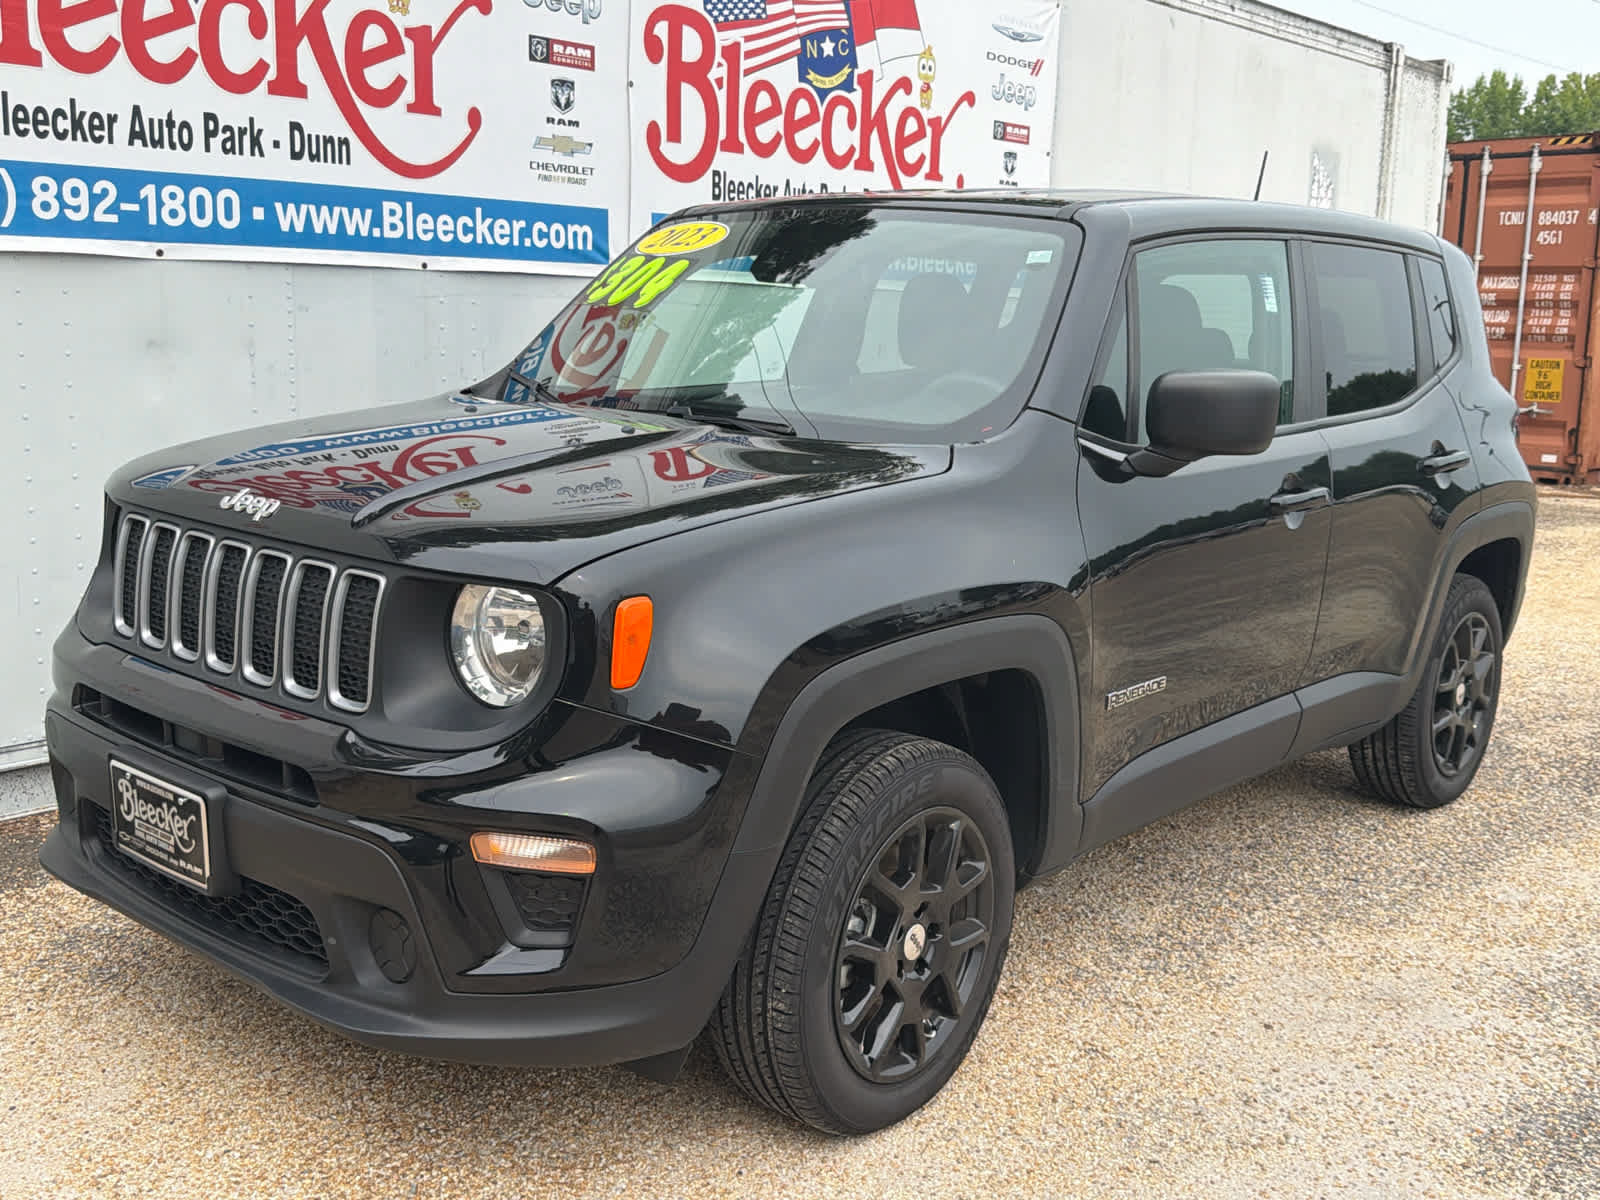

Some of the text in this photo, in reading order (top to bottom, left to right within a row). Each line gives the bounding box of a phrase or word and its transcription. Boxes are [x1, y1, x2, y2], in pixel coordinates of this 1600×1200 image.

[553, 44, 592, 58] RAM
[806, 39, 818, 58] N
[986, 51, 1037, 71] DODGE
[644, 4, 976, 189] Bleecker
[991, 73, 1036, 111] Jeep
[546, 116, 580, 128] RAM
[128, 104, 194, 151] Auto
[203, 112, 265, 158] Park
[289, 121, 351, 166] Dunn
[529, 160, 595, 176] CHEVROLET
[31, 175, 241, 229] 892-1800
[274, 201, 593, 251] www.Bleecker.com
[1499, 211, 1525, 226] TCNU
[1538, 210, 1580, 226] 884037
[644, 227, 720, 248] 2023
[1530, 360, 1560, 369] CAUTION
[221, 488, 281, 521] Jeep
[1106, 676, 1167, 711] RENEGADE
[118, 778, 196, 853] Bleecker
